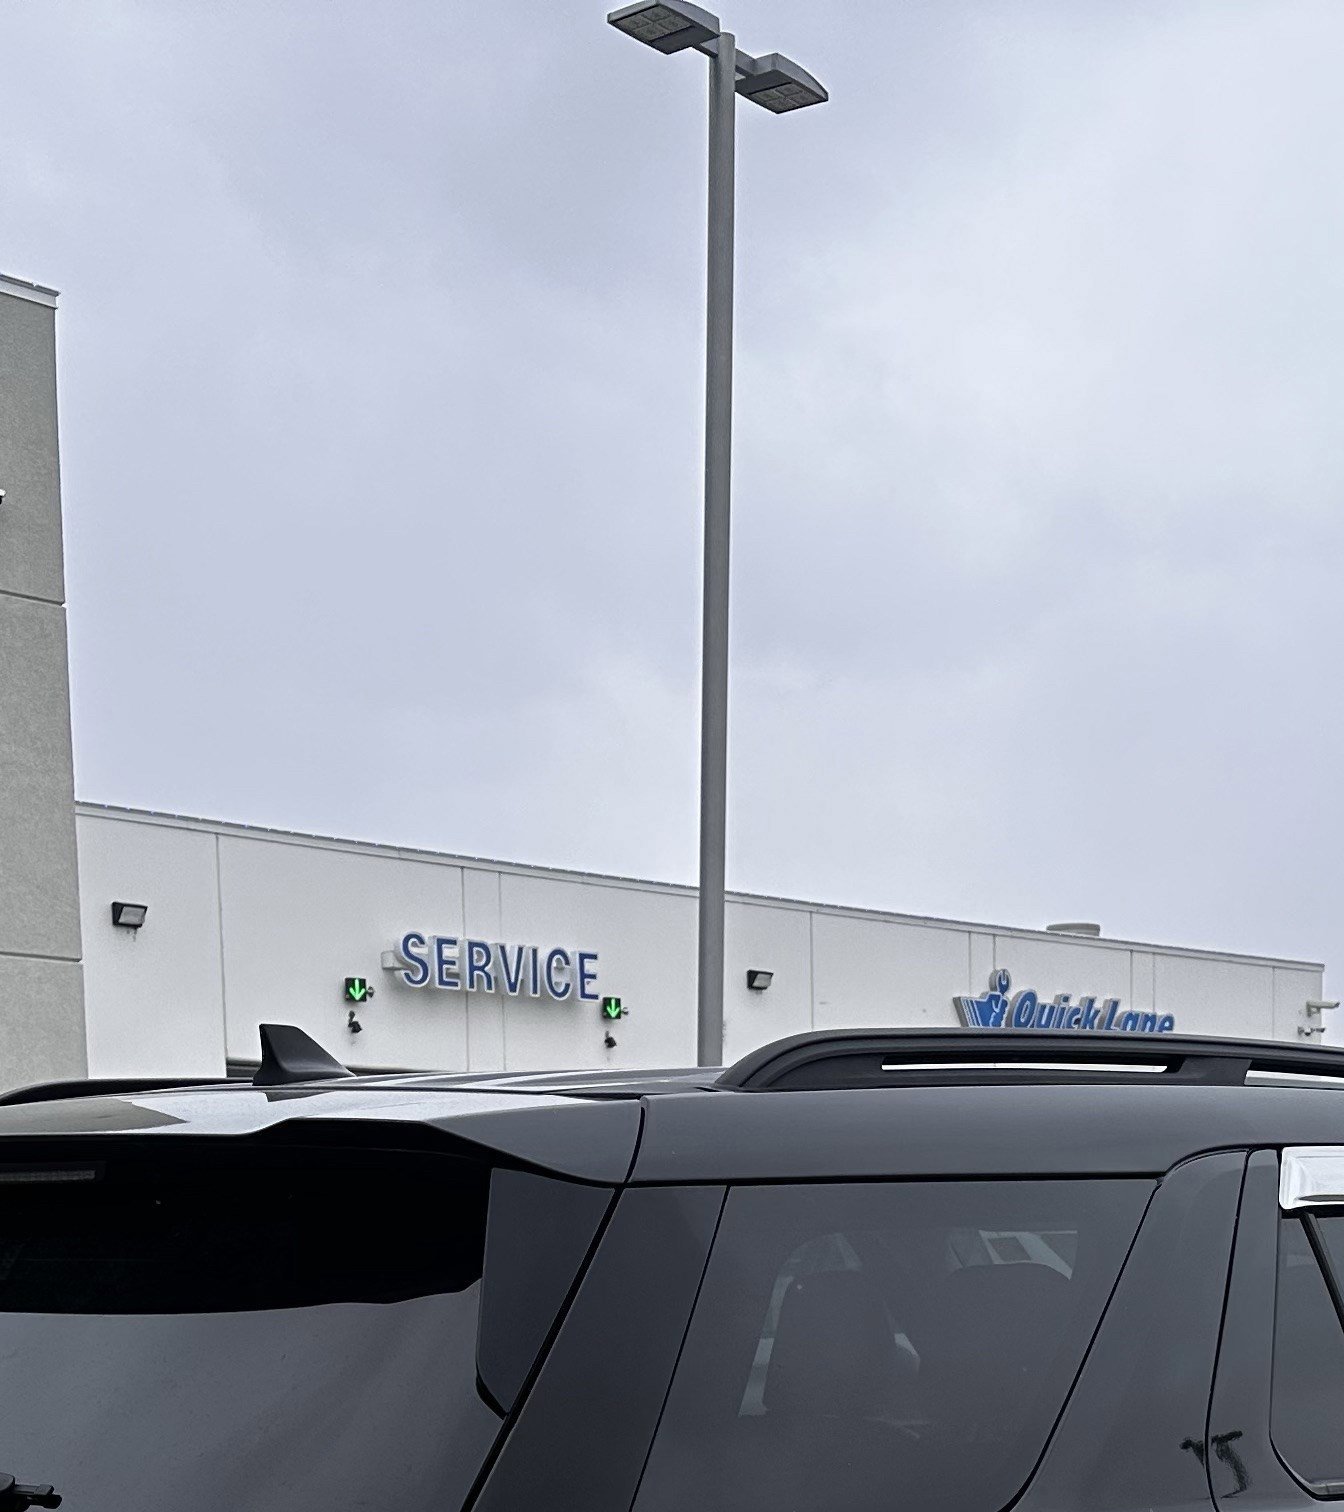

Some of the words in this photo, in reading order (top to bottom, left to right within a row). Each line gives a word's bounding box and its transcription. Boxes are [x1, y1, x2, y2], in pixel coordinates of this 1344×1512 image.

[400, 931, 600, 1002] SERVICE
[1011, 990, 1100, 1031] Quick
[1104, 998, 1175, 1034] Lane
